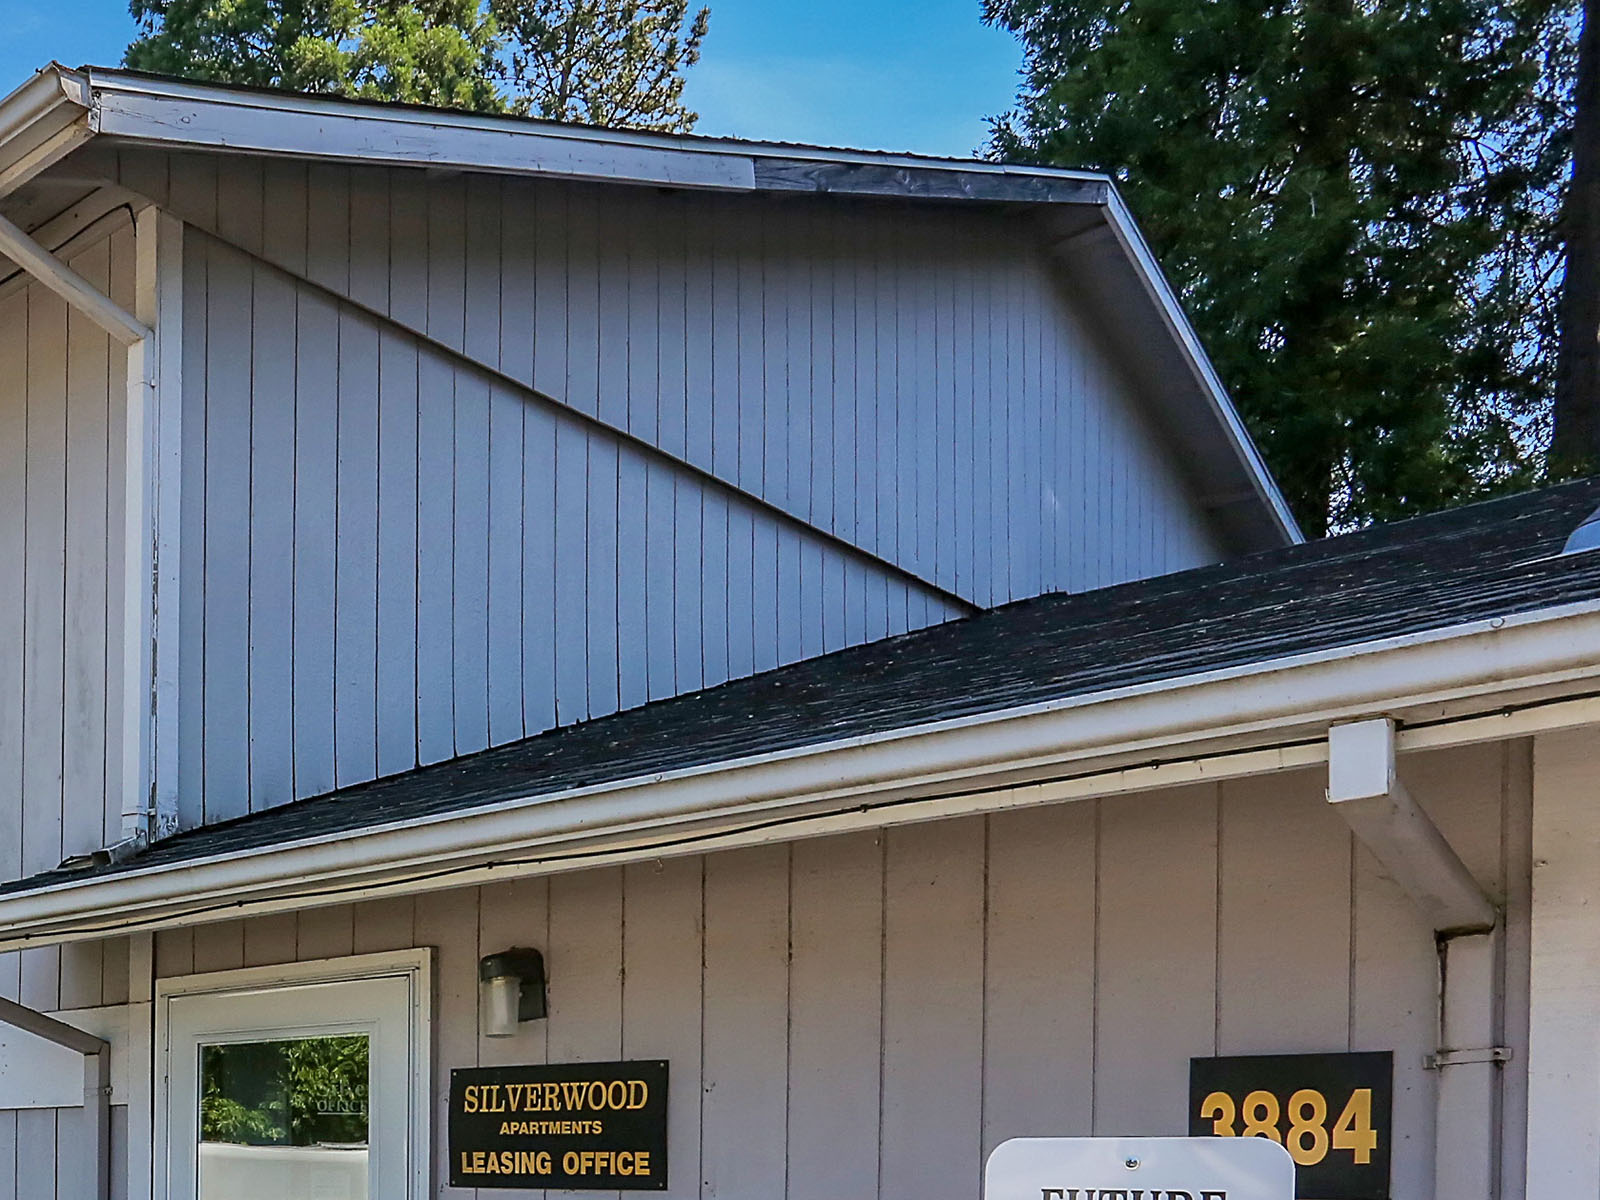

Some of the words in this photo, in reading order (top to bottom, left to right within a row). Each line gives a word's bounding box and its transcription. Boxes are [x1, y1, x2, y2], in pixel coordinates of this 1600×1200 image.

[464, 1080, 649, 1113] SILVERWOOD
[499, 1120, 603, 1135] APARTMENTS
[1200, 1087, 1378, 1166] 3884
[461, 1151, 552, 1175] LEASING
[562, 1151, 651, 1176] OFFICE
